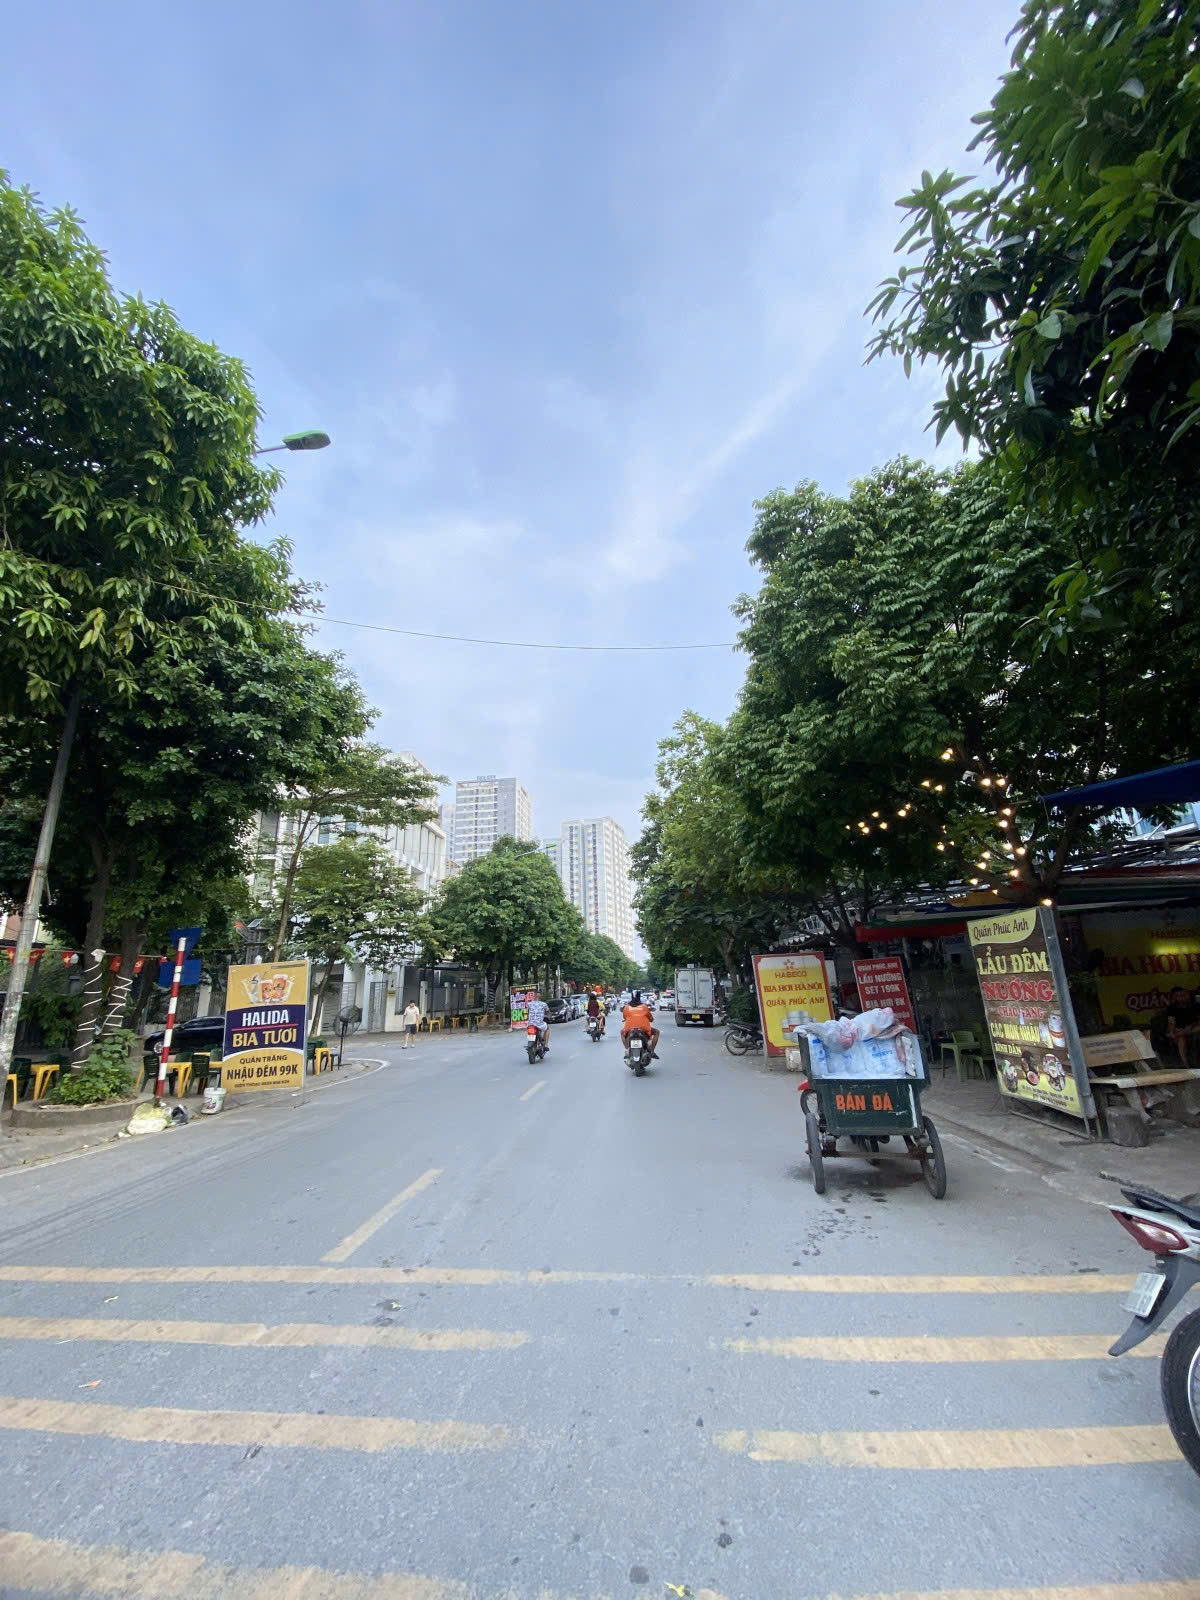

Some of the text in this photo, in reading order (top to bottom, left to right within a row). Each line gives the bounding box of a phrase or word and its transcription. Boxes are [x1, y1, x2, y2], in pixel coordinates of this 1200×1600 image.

[974, 918, 1029, 940] Quán Phúc Anh
[977, 946, 1049, 975] LẨU ĐÊM
[794, 982, 806, 991] HÀ
[865, 986, 878, 994] SET
[982, 976, 1053, 1001] NƯỚNG
[788, 996, 807, 1005] PHÚC
[810, 996, 825, 1004] ANH
[242, 1010, 289, 1026] HALIDA
[232, 1028, 297, 1047] BIA TƯƠI
[240, 1056, 261, 1064] QUÁN
[227, 1064, 298, 1082] NHẬU ĐÊM 99K
[835, 1092, 893, 1111] BÁN ĐÁ
